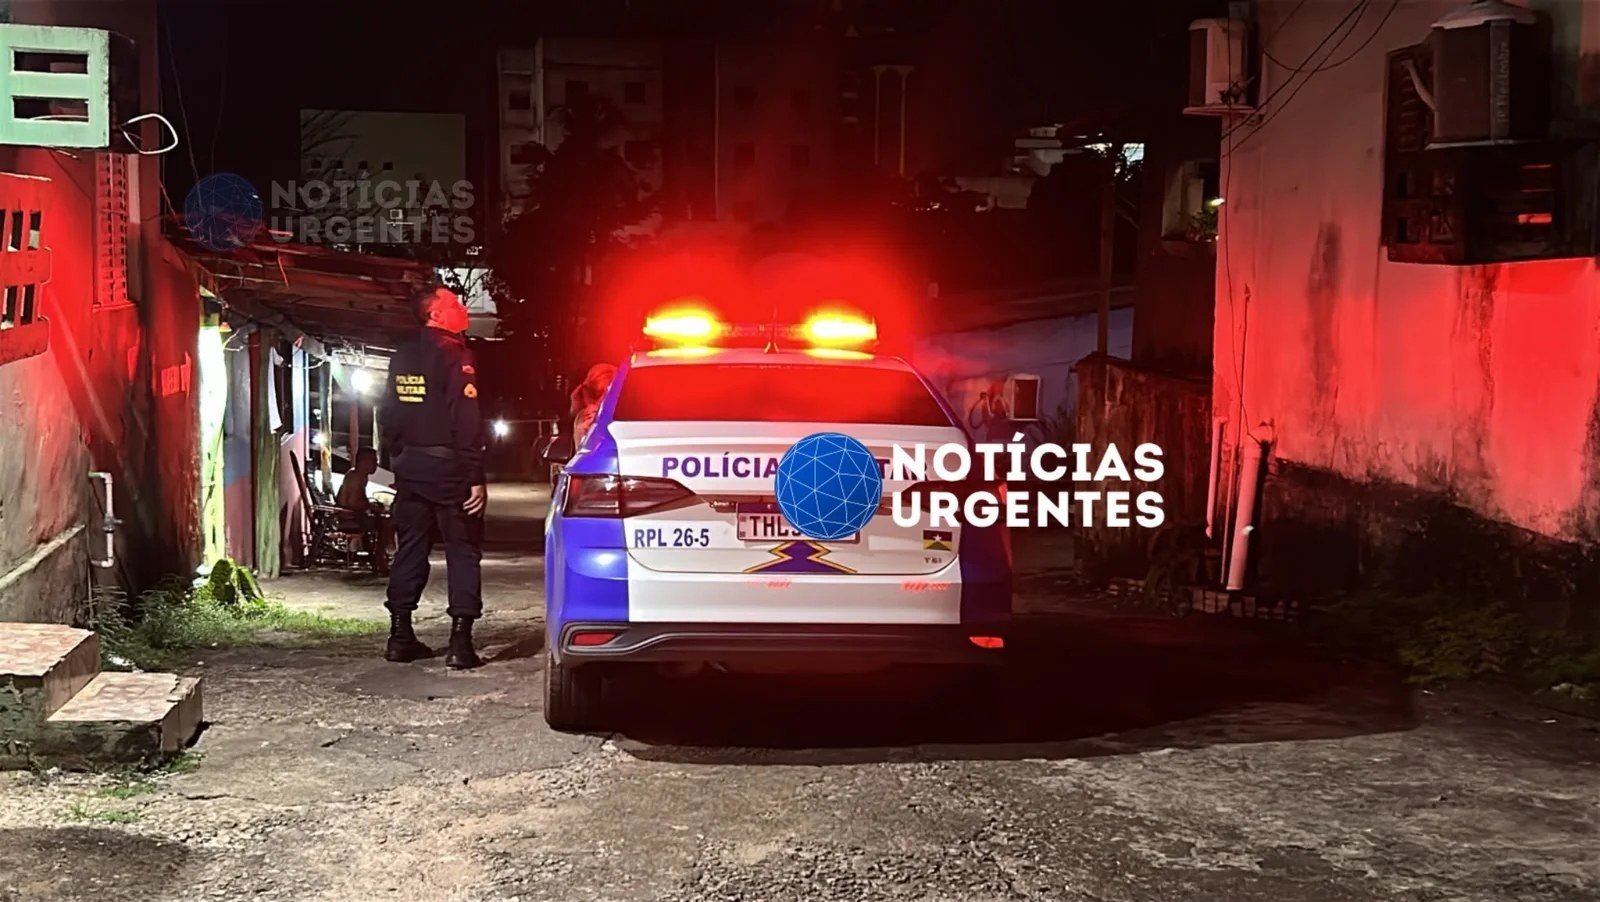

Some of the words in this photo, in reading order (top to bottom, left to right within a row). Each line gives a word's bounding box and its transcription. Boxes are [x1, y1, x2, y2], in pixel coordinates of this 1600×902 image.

[662, 451, 779, 478] POLÍCIA
[634, 528, 668, 548] RPL
[673, 528, 710, 547] 26-5
